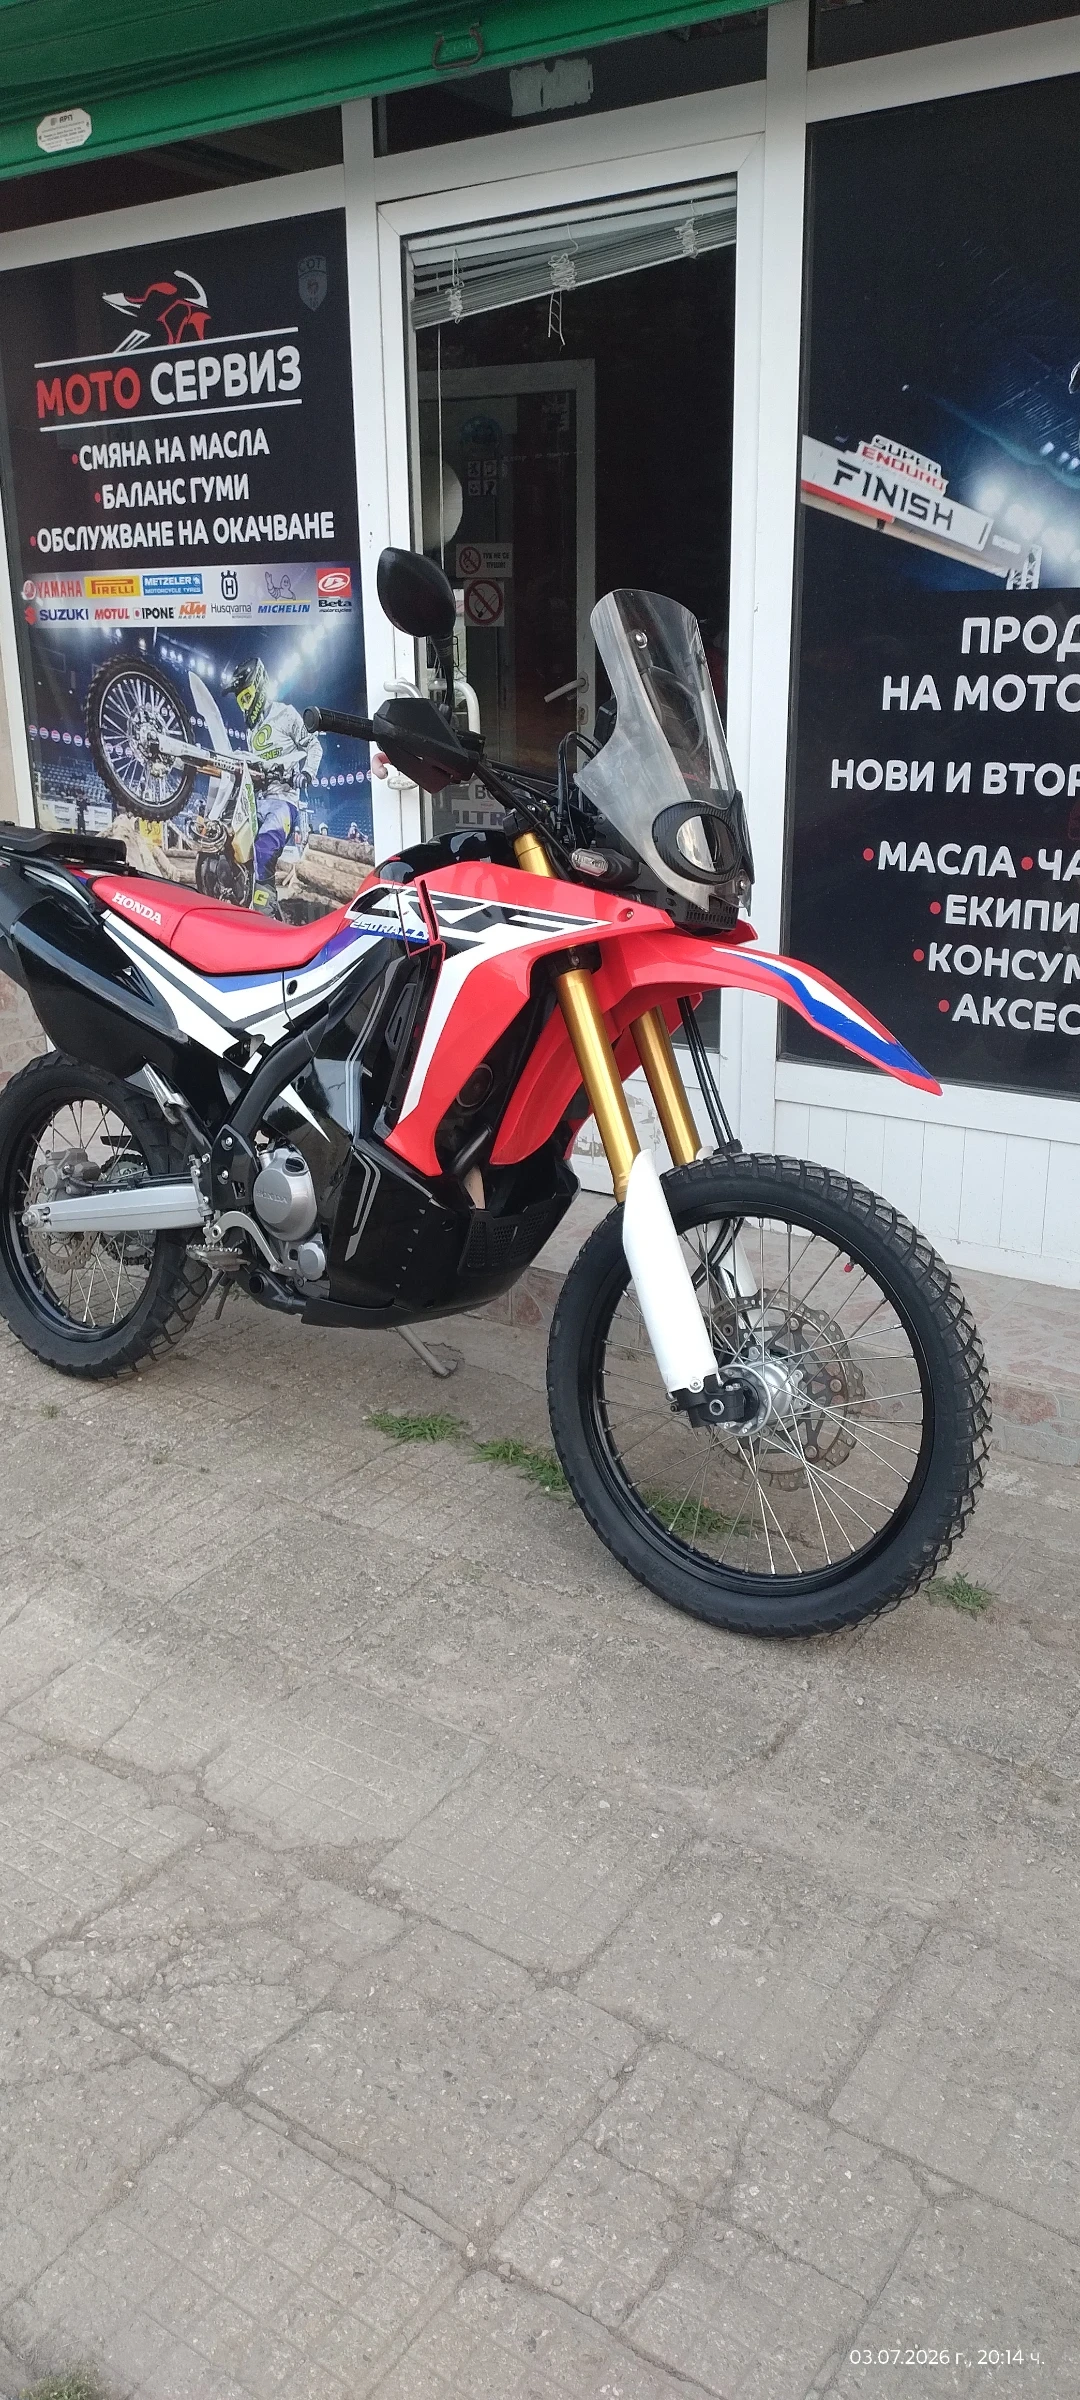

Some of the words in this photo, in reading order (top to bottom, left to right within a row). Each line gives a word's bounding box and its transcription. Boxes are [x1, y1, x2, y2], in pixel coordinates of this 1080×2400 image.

[36, 367, 141, 419] МОТО
[150, 345, 302, 406] СЕРВИЗ
[79, 439, 151, 471] СМЯНА
[155, 436, 186, 464] НА
[190, 428, 270, 461] МАСЛА
[102, 478, 187, 510] БАЛАНС
[190, 473, 250, 503] ГУМИ
[833, 459, 954, 531] FINISH
[37, 521, 174, 553] ОБСЛУЖВАНЕ
[179, 519, 209, 546] НА
[212, 511, 335, 545] ОКАЧВАНЕ
[36, 580, 83, 598] YAMAHA
[91, 579, 134, 594] PIRELLI
[144, 576, 192, 586] METZELER
[40, 608, 89, 621] SUZUKI
[94, 608, 130, 620] MOTUL
[142, 607, 174, 619] IPONE
[179, 602, 207, 615] KTM
[211, 603, 252, 614] Husqvarna
[257, 604, 310, 614] MICHELIN
[318, 599, 352, 608] Beta
[882, 674, 942, 711] НА
[953, 673, 1080, 712] МОТО
[831, 758, 935, 792] НОВИ
[946, 761, 972, 793] И
[877, 840, 1017, 878] МАСЛА
[1038, 849, 1080, 881] ЧА
[111, 892, 162, 926] HONDA
[945, 894, 1080, 934] ЕКИПИ
[951, 993, 1080, 1036] АКСЕС
